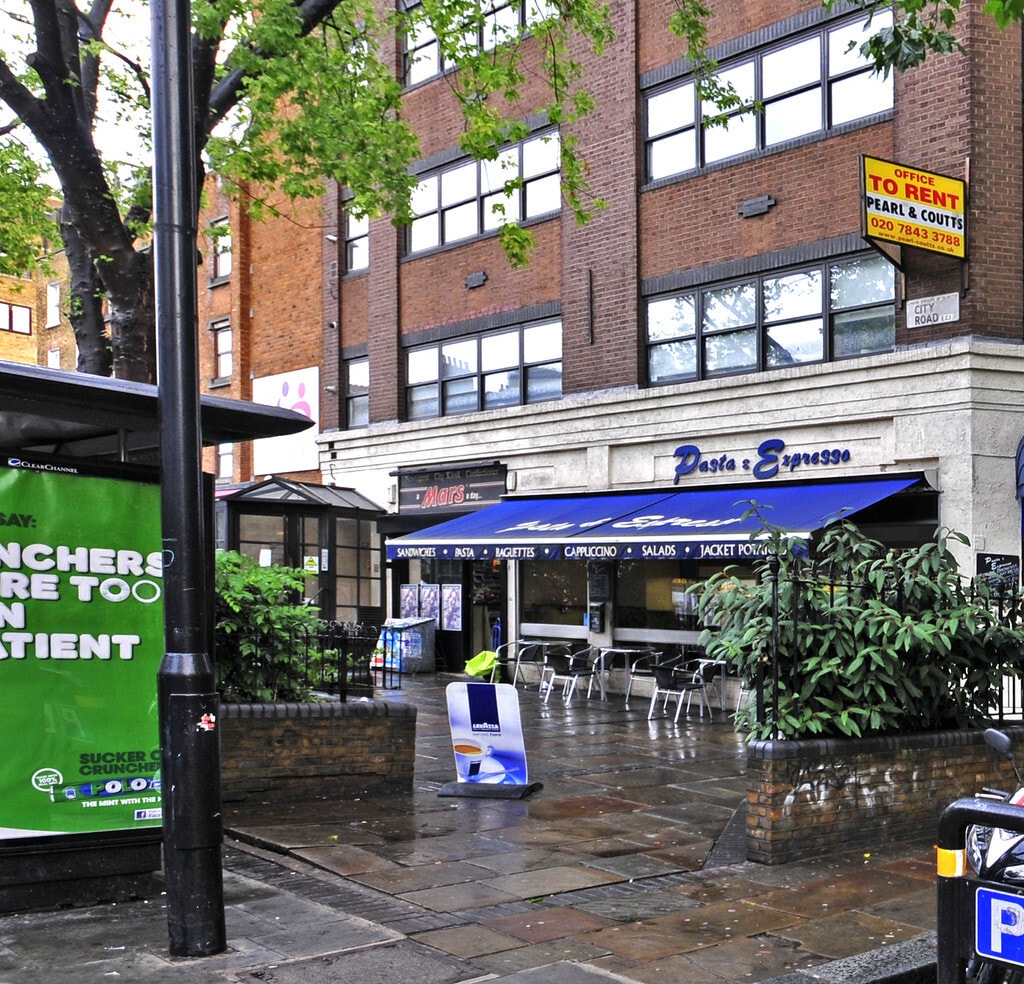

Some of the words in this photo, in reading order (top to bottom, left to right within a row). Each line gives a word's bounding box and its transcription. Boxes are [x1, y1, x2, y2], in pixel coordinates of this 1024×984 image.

[894, 168, 935, 186] OFFICE
[868, 174, 898, 195] TO
[905, 182, 959, 210] RENT
[867, 195, 905, 217] PEARL
[908, 206, 917, 219] &
[921, 209, 963, 230] COUTTS
[871, 217, 894, 231] 020
[898, 223, 929, 239] 7843
[932, 231, 961, 247] 3788
[914, 302, 935, 315] CITY
[914, 313, 939, 325] ROAD
[673, 444, 736, 485] Pasta
[752, 438, 851, 480] Expresso
[421, 484, 465, 509] Mars
[397, 547, 436, 557] SANDWICHES
[454, 547, 475, 557] PASTA
[495, 547, 535, 557] BAGUETTES
[564, 545, 618, 558] CAPPUCCINO
[642, 545, 676, 557] SALADS
[700, 544, 736, 558] JACKET
[69, 576, 161, 604] TOO
[79, 750, 147, 765] SUCKER
[90, 777, 149, 797] POLO
[82, 800, 99, 808] THE
[99, 799, 119, 807] MINT
[120, 797, 141, 805] WITH
[142, 796, 156, 804] THE
